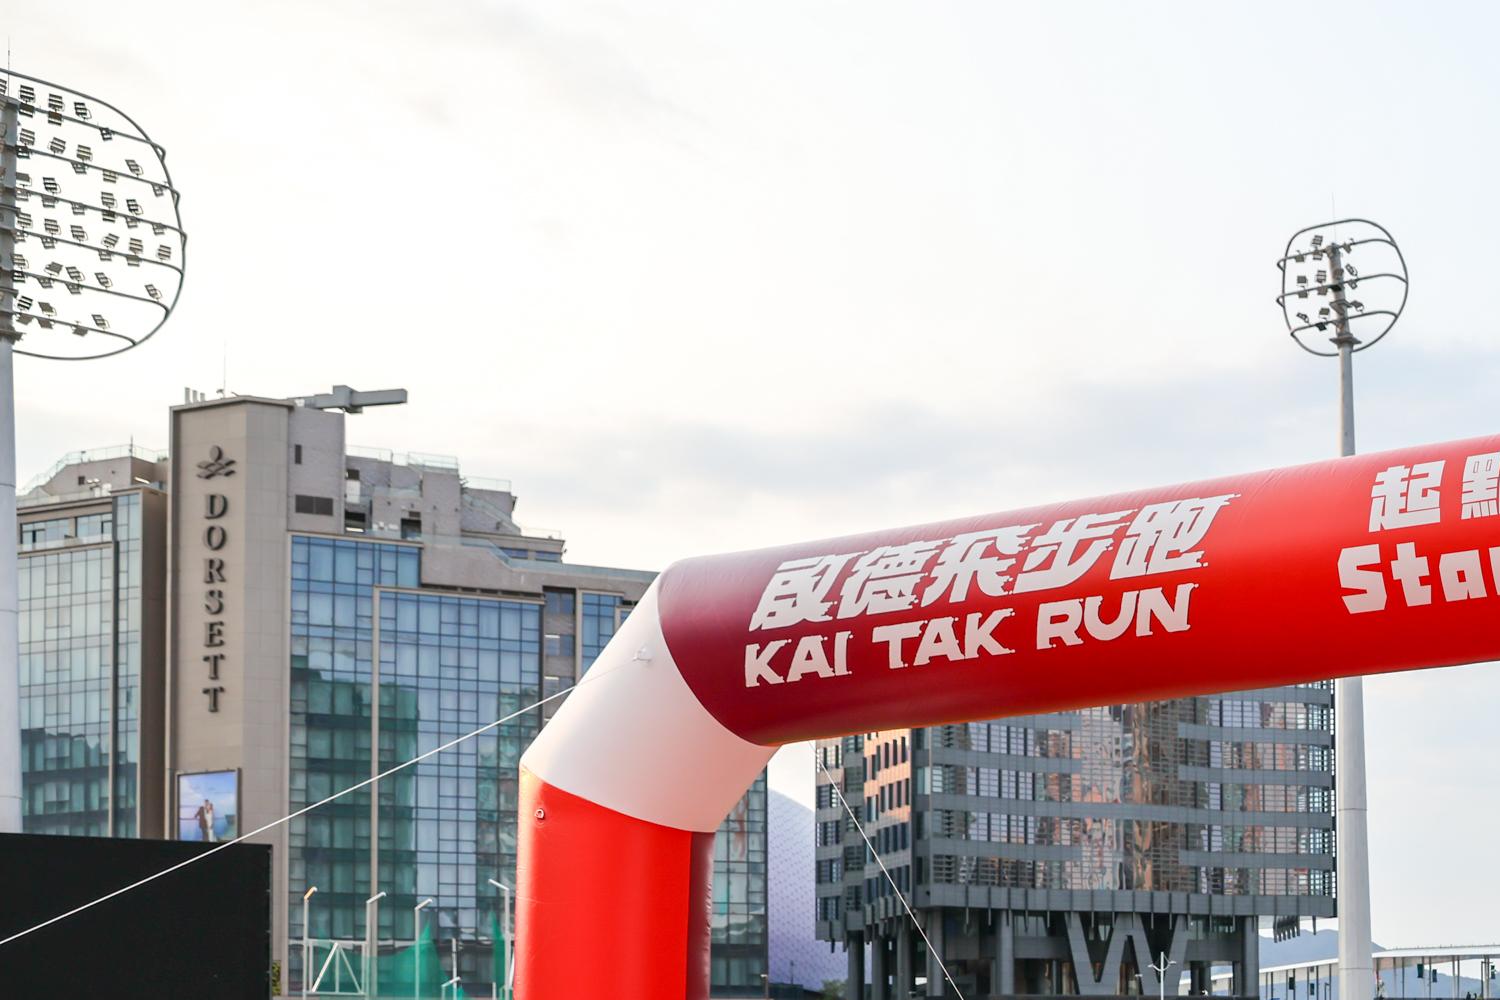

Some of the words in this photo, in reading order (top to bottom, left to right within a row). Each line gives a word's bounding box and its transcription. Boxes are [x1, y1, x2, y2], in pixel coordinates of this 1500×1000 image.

[203, 493, 228, 713] DORSETT
[745, 631, 854, 688] KAI
[872, 608, 1015, 670] TAK
[1036, 583, 1199, 650] RUN
